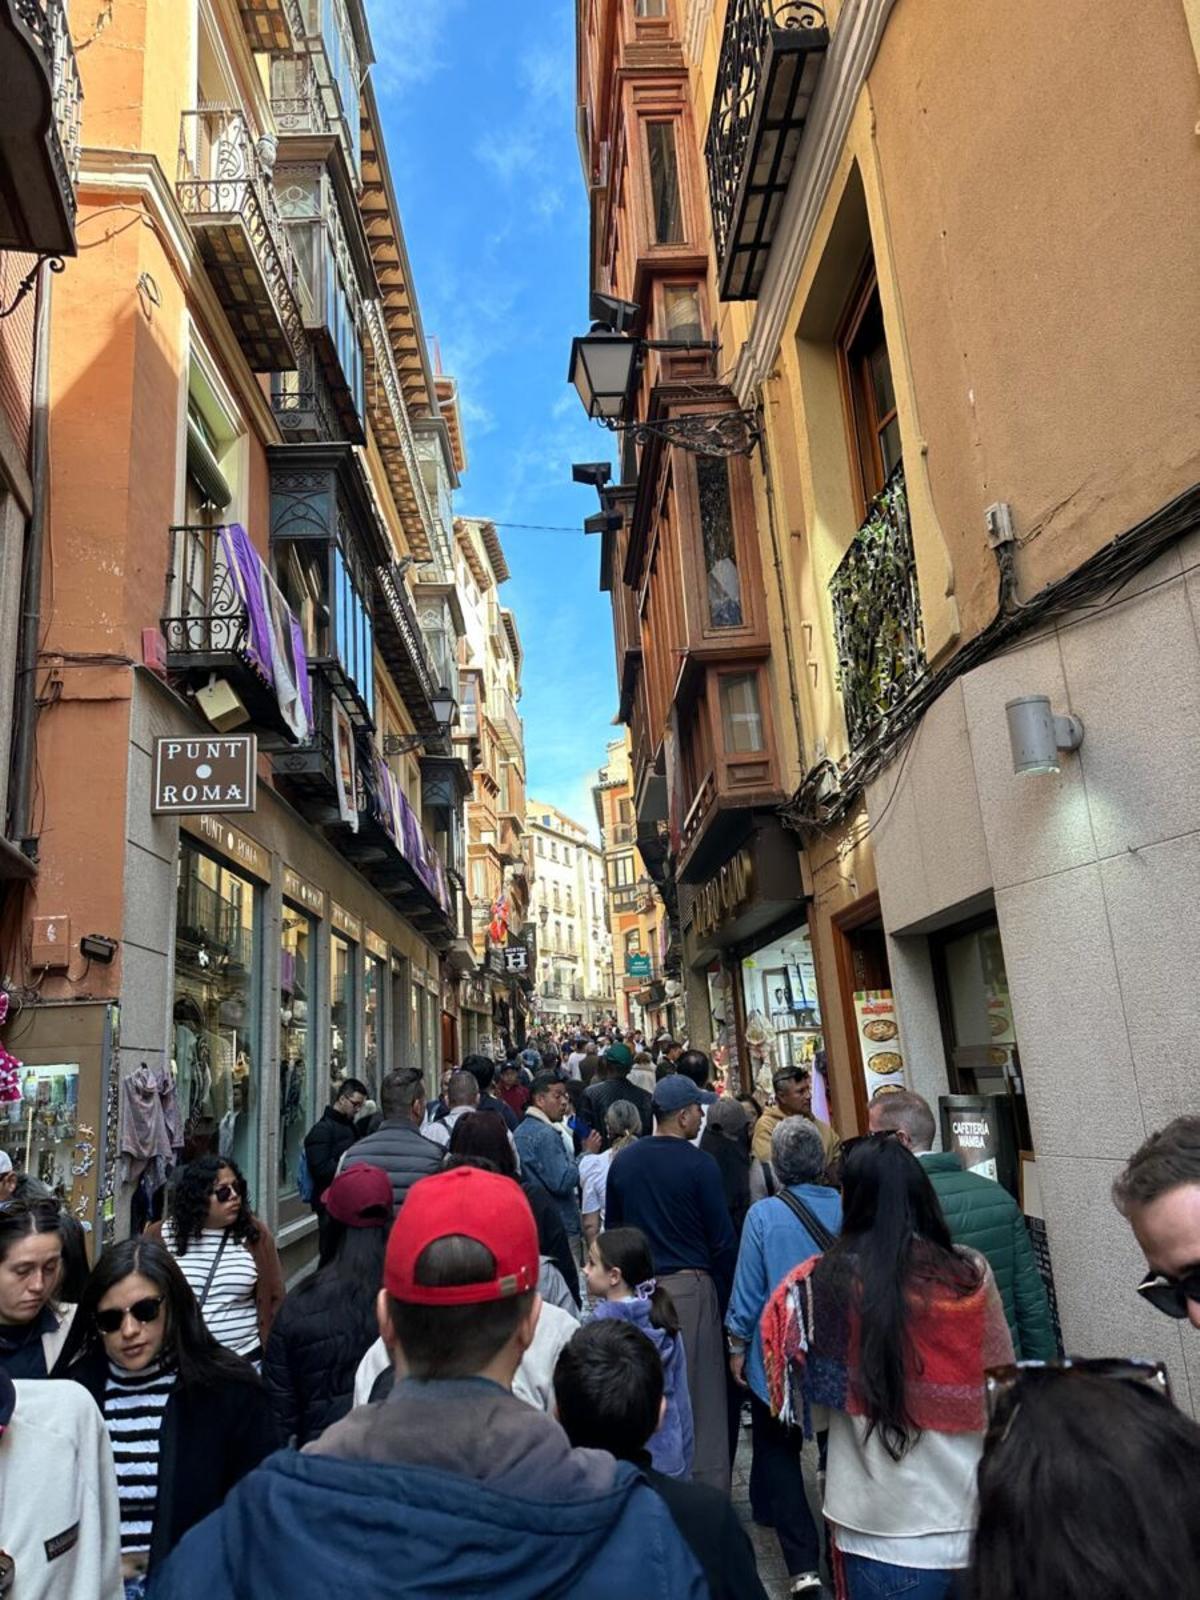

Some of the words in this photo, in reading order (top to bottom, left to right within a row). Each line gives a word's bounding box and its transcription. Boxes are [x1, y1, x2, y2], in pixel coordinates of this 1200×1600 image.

[167, 742, 242, 760] PUNT
[163, 784, 242, 804] ROMA
[200, 814, 224, 844] PUNT
[952, 1118, 990, 1135] CAFETERÍA
